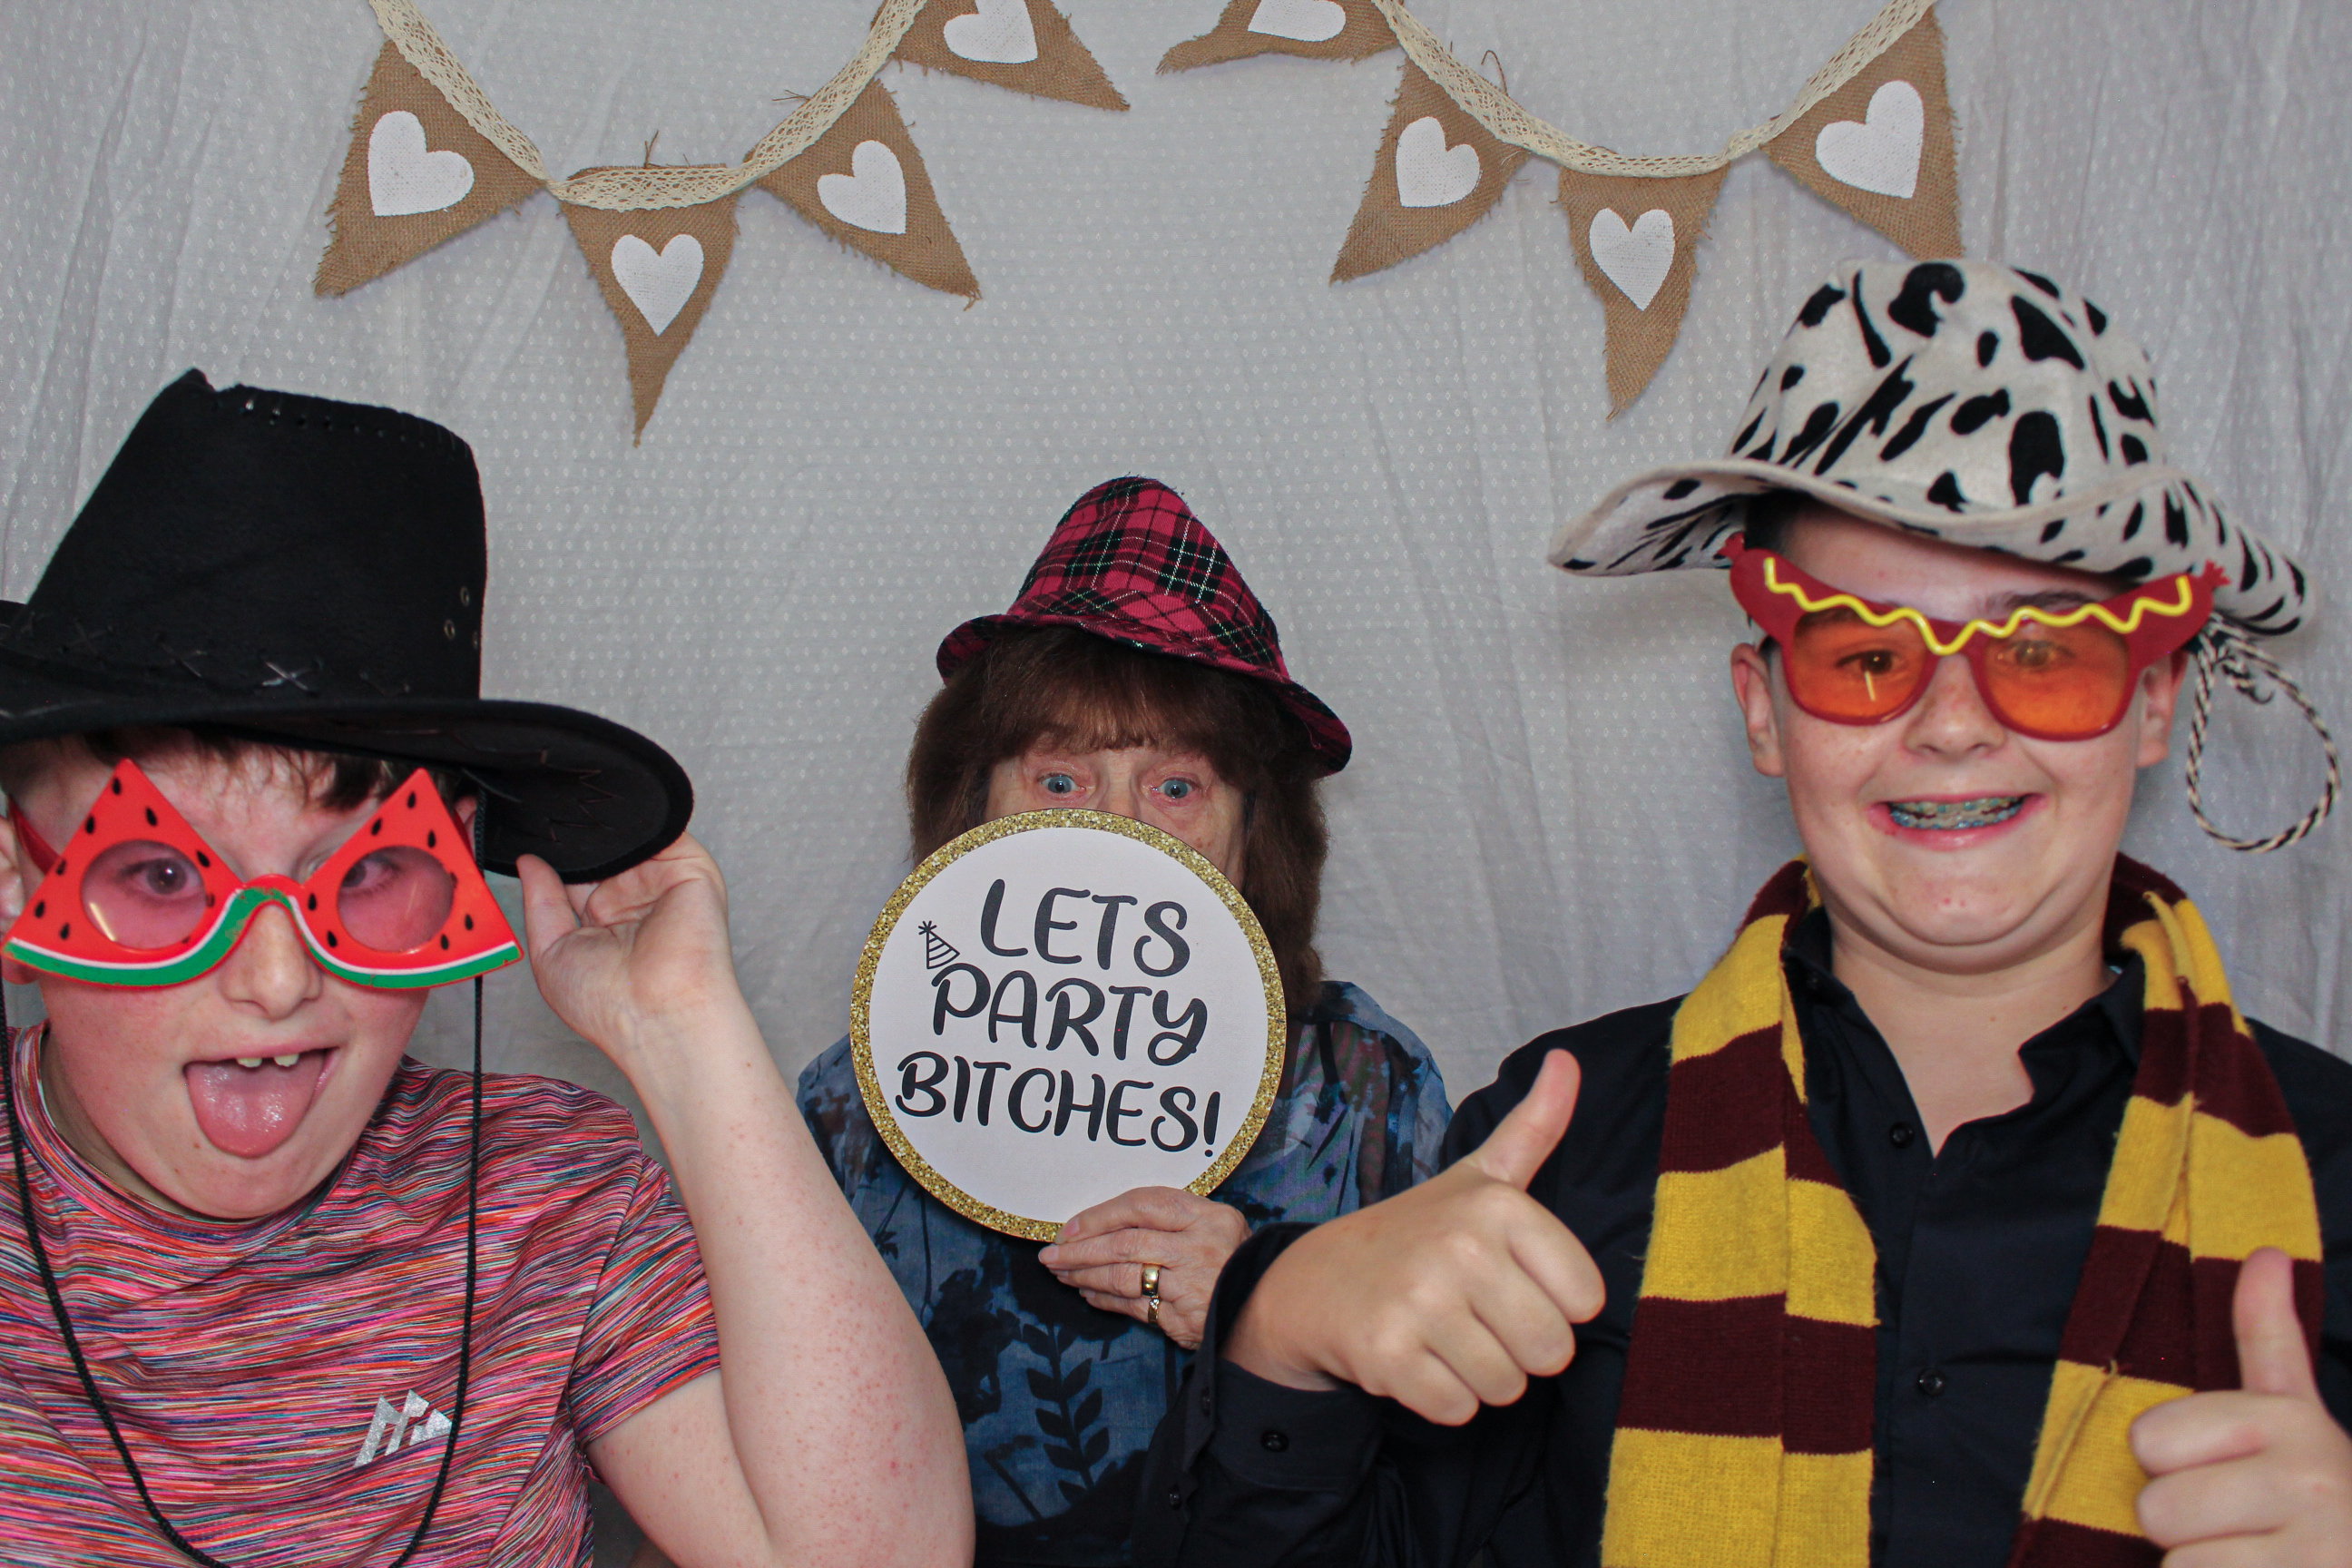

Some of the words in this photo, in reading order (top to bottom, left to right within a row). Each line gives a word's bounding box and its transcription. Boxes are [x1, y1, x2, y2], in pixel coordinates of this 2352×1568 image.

[980, 878, 1191, 977] LETS
[931, 963, 1208, 1066] PARTY
[895, 1051, 1221, 1158] BITCHES!
